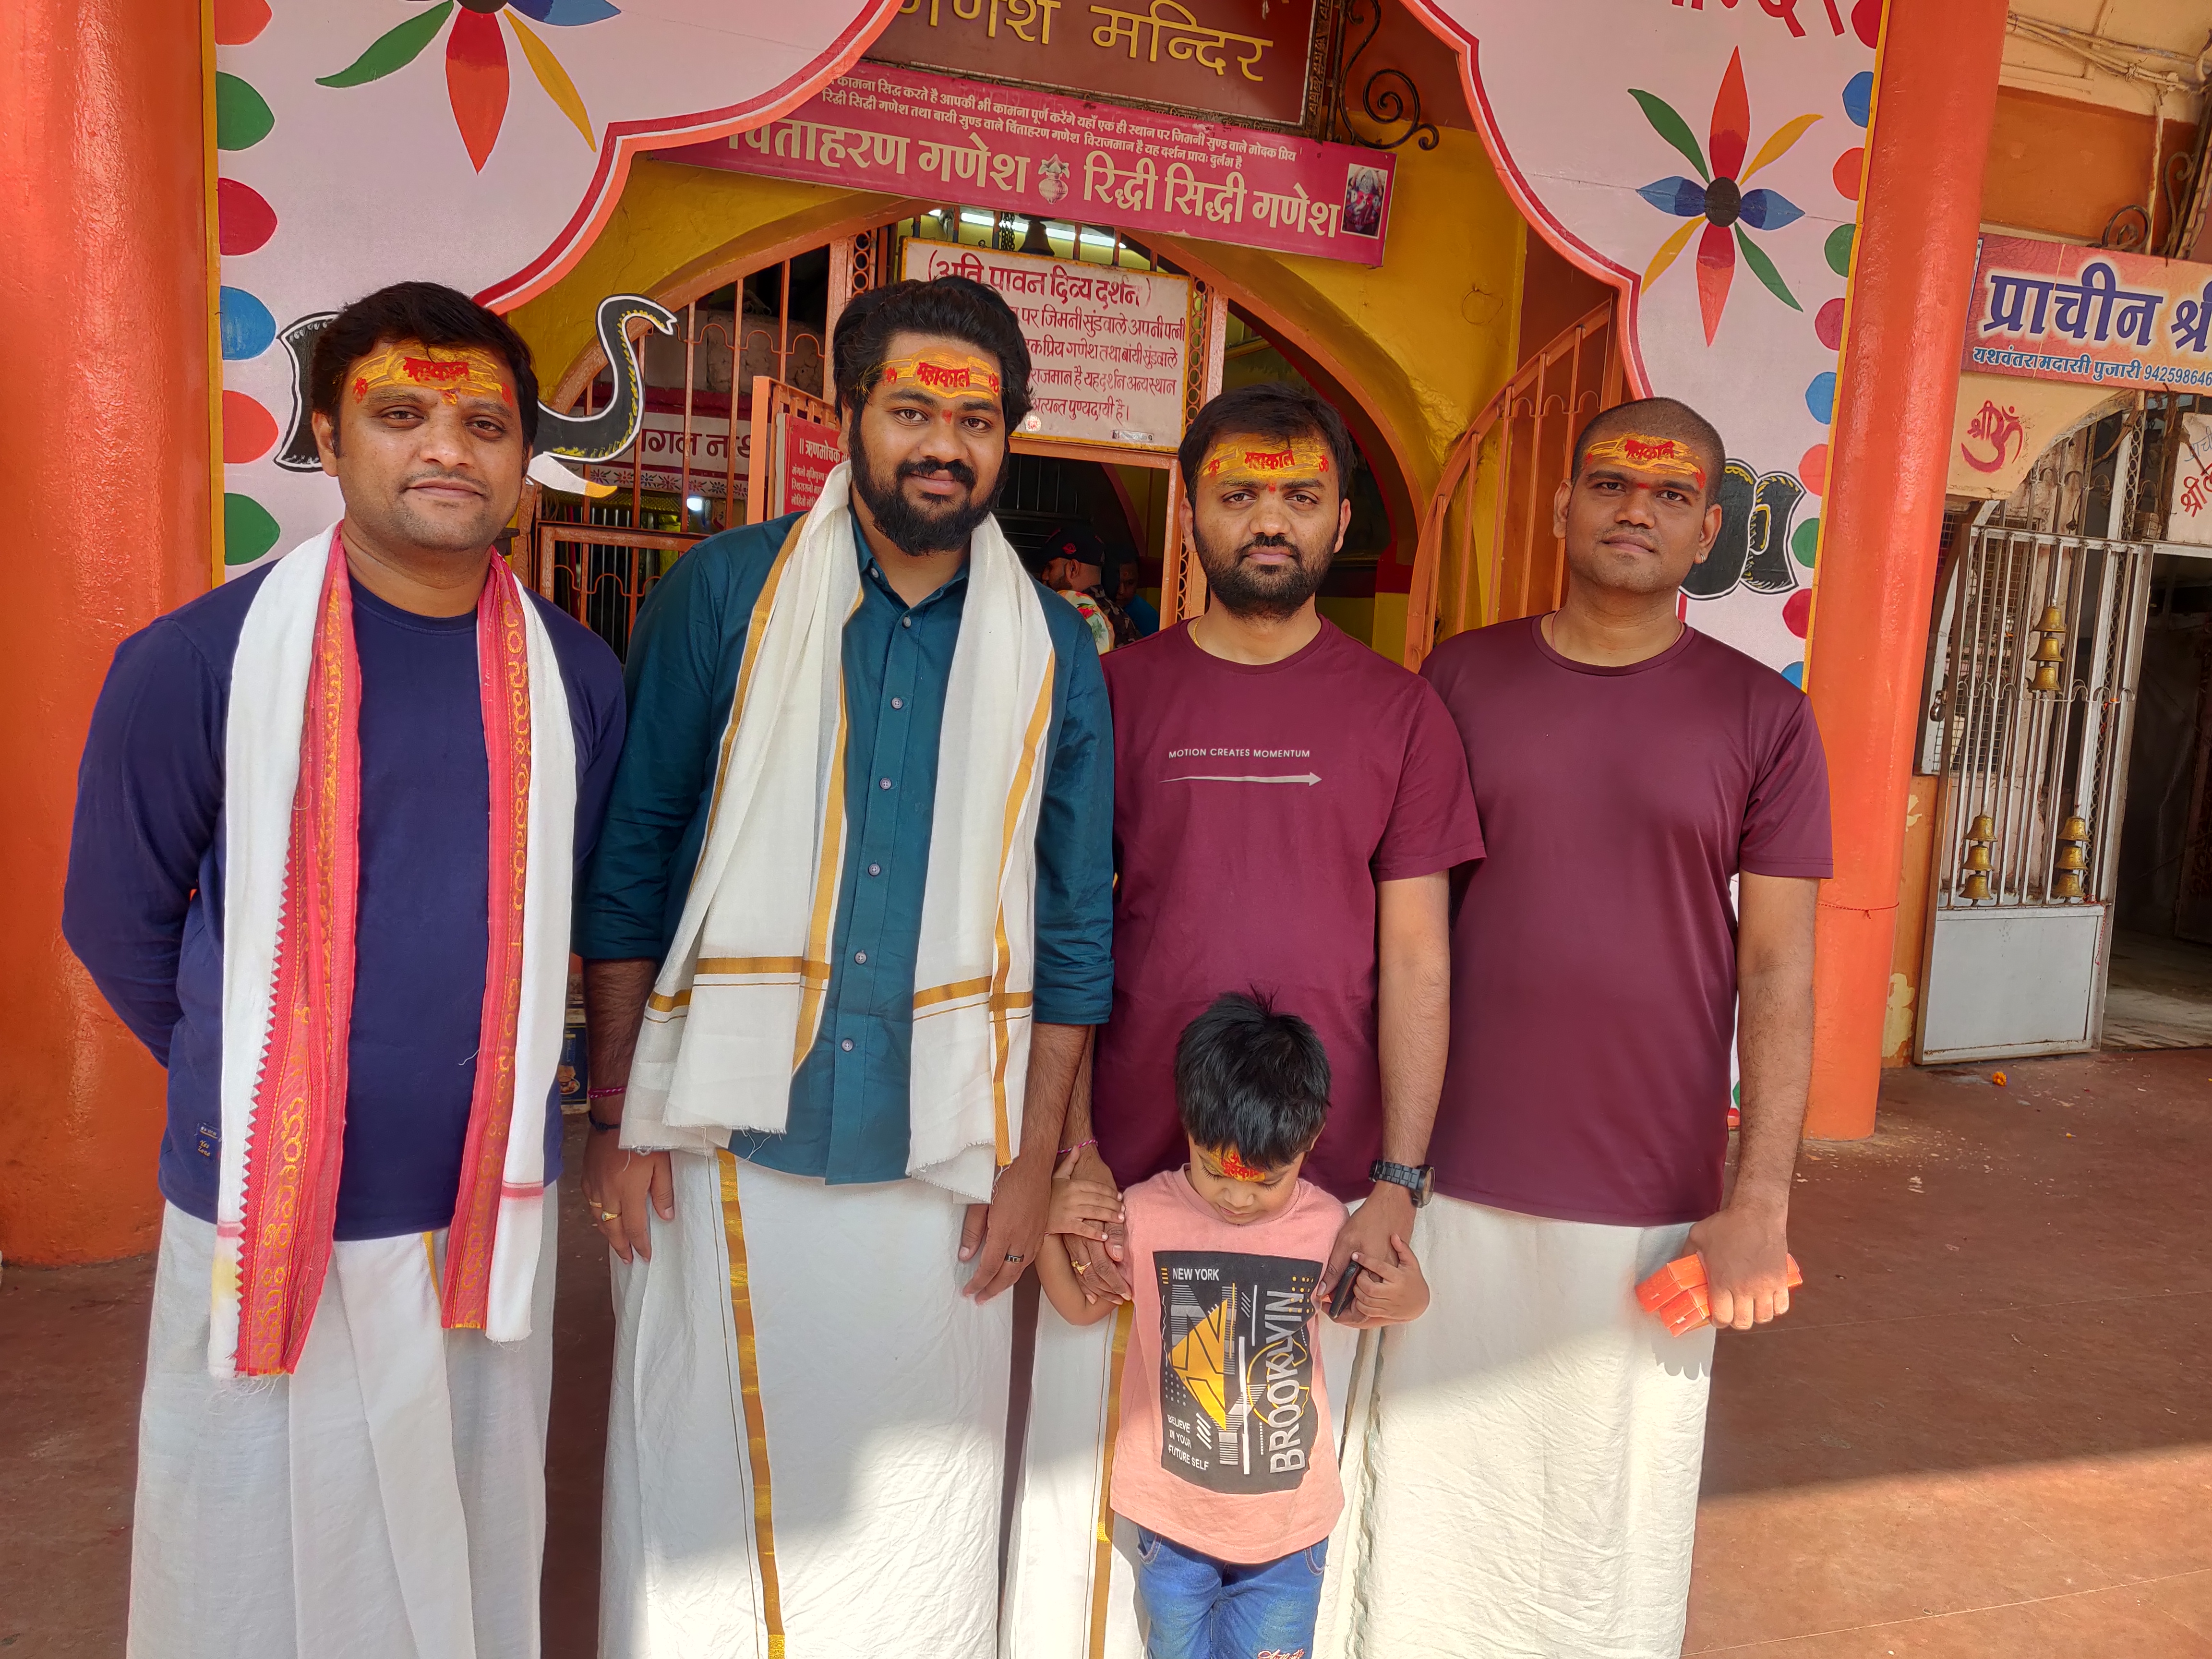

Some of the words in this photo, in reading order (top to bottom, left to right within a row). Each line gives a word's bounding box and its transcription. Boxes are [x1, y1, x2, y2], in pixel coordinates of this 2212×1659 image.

[1090, 0, 1274, 82] मन्दिर
[822, 88, 847, 105] रिद्धी
[849, 91, 877, 110] सिद्धी
[878, 98, 910, 116] गणेश
[911, 105, 931, 120] तथा
[959, 114, 983, 131] सुण्ड
[984, 117, 1004, 132] वाले
[1006, 119, 1050, 139] चिंताहरण
[1051, 128, 1080, 144] गणेश
[1083, 131, 1135, 153] विराजमान
[1136, 139, 1145, 154] है
[1144, 144, 1160, 157] यह
[1161, 145, 1186, 160] दर्शन
[1210, 153, 1234, 169] दुर्लभ
[1235, 155, 1243, 169] है
[838, 77, 876, 92] कामना
[878, 79, 902, 97] सिद्ध
[903, 86, 928, 101] करते
[930, 88, 939, 104] है
[940, 94, 975, 109] आपकी
[977, 97, 991, 112] भी
[993, 102, 1030, 119] कामना
[1031, 108, 1050, 125] पूर्ण
[1077, 114, 1098, 129] यहाँ
[1098, 120, 1115, 132] एक
[1116, 119, 1128, 134] ही
[1128, 124, 1155, 139] स्थान
[1156, 129, 1171, 141] पर
[1171, 128, 1205, 146] जिमनी
[1206, 136, 1227, 152] सुण्ड
[1229, 139, 1247, 154] वाले
[1248, 142, 1277, 158] मोदक
[1278, 146, 1297, 162] प्रिय
[918, 132, 1031, 193] गणेश
[1083, 150, 1159, 211] रिद्धी
[1164, 162, 1248, 224] सिद्धी
[1251, 182, 1341, 238] गणेश
[989, 266, 1047, 296] पावन
[1050, 264, 1093, 304] दिव्य
[1984, 263, 2164, 346] प्राचीन
[1022, 307, 1040, 328] पर
[1042, 303, 1082, 331] जिमनी
[1128, 315, 1164, 339] अपनी
[1165, 317, 1186, 342] पत्नी
[1043, 335, 1065, 358] प्रिय
[1066, 338, 1098, 360] गणेश
[1100, 345, 1122, 363] तथा
[1074, 365, 1082, 390] है
[2093, 360, 2142, 380] पुजारी
[1069, 396, 1115, 421] पुण्यदायी
[805, 439, 841, 463] ऋणमोचक
[1169, 749, 1206, 758] MOTION
[1210, 748, 1250, 757] CREATES
[1253, 749, 1310, 758] MOMENTUM
[1173, 1268, 1192, 1280] NEW
[1194, 1269, 1220, 1281] YORK
[1167, 1414, 1190, 1433] BELIEVE
[1169, 1429, 1175, 1440] IN
[1176, 1432, 1192, 1449] YOUR
[1168, 1444, 1190, 1464] FUTURE
[1191, 1457, 1209, 1470] SELF
